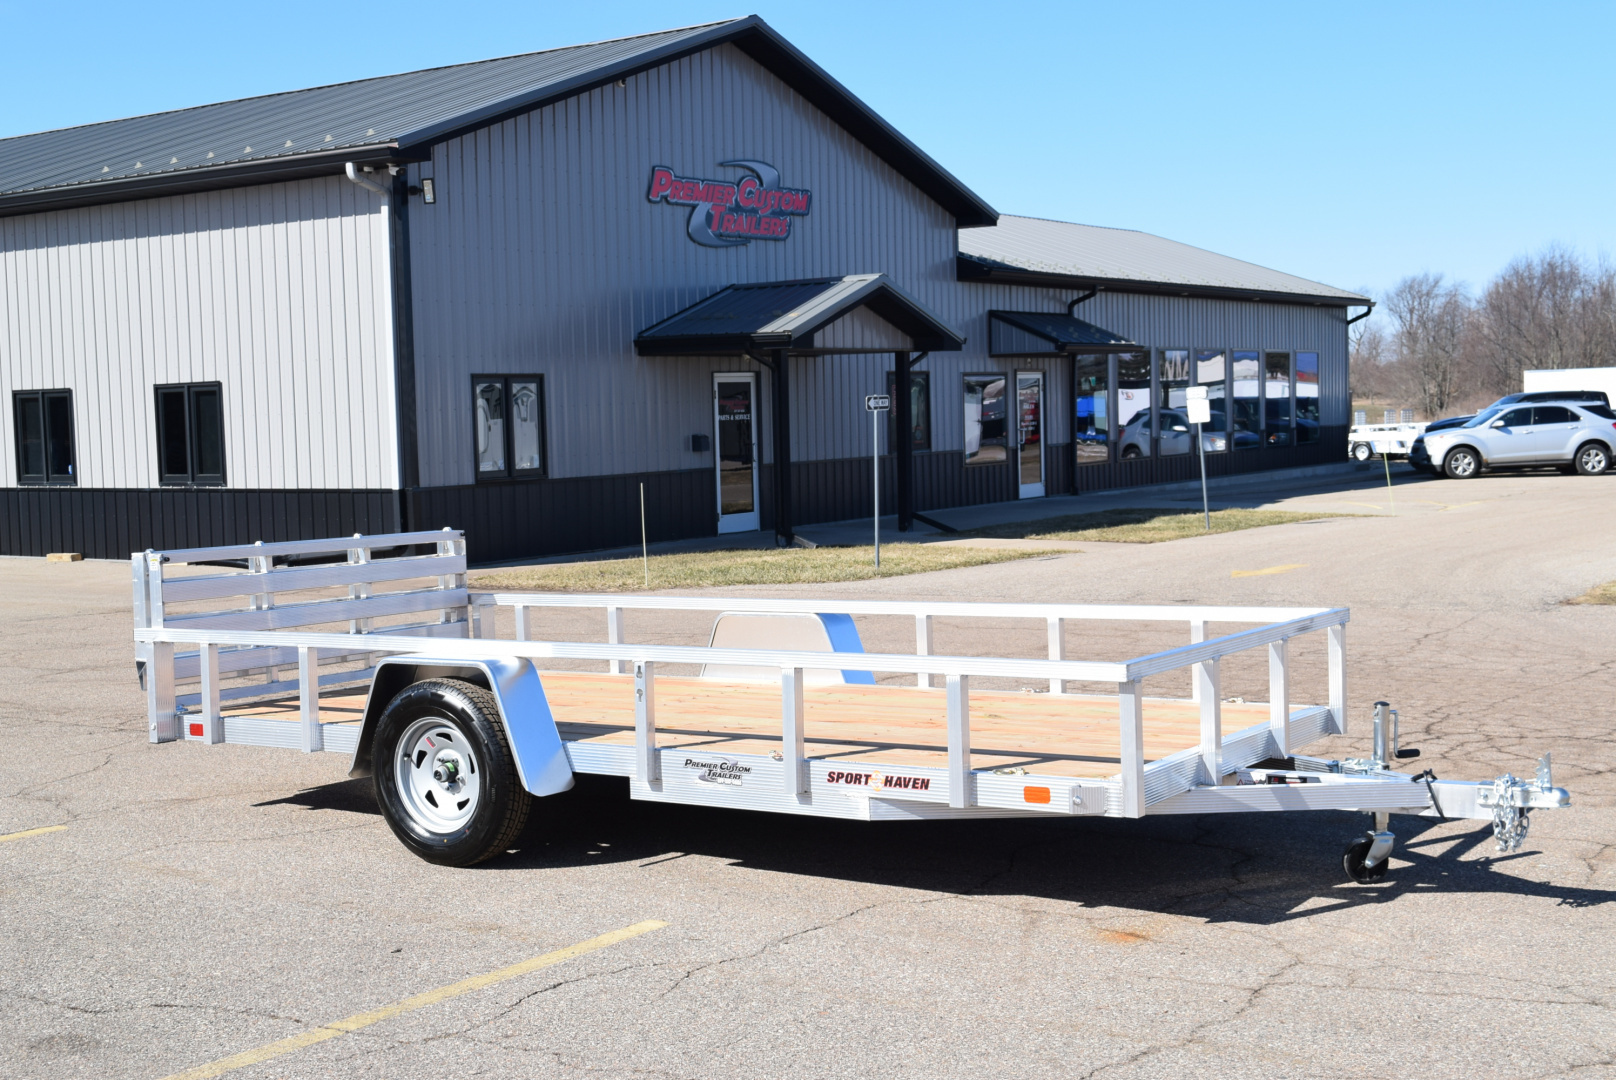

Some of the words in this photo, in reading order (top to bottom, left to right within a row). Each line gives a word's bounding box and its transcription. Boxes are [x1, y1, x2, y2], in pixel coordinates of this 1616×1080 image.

[650, 169, 736, 205] PREMIER
[738, 178, 810, 215] CUSTOM
[709, 204, 790, 237] TRAILERS
[684, 758, 718, 770] PREMIER
[719, 762, 751, 773] CUSTOM
[706, 769, 742, 780] TRAILERS
[826, 770, 872, 786] SPORT
[883, 775, 931, 791] HAVEN
